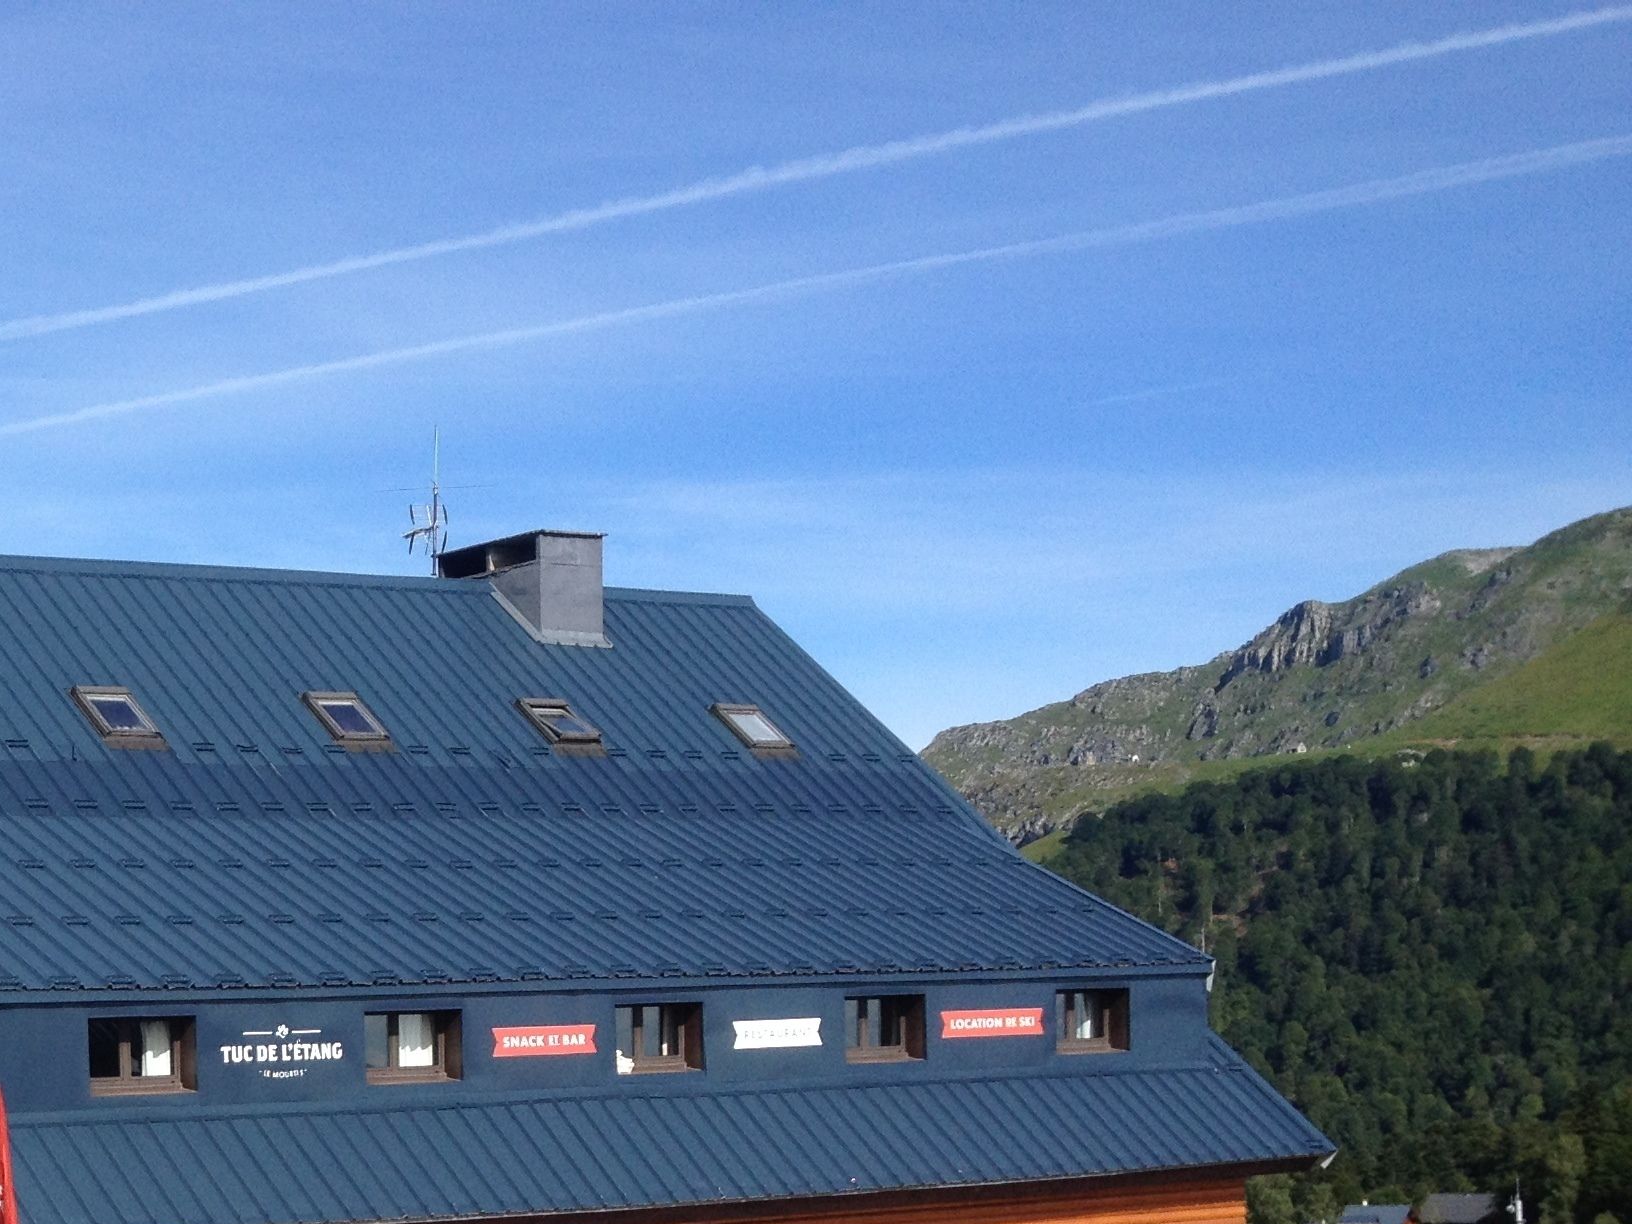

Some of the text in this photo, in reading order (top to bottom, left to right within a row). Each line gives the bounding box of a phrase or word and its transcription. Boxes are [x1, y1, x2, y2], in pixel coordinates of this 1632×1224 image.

[950, 1018, 1003, 1030] LOCATION
[1019, 1016, 1035, 1027] SKI
[503, 1035, 545, 1048] SNACK
[562, 1034, 586, 1045] BAR
[220, 1045, 254, 1063] TUC
[256, 1044, 278, 1062] DE
